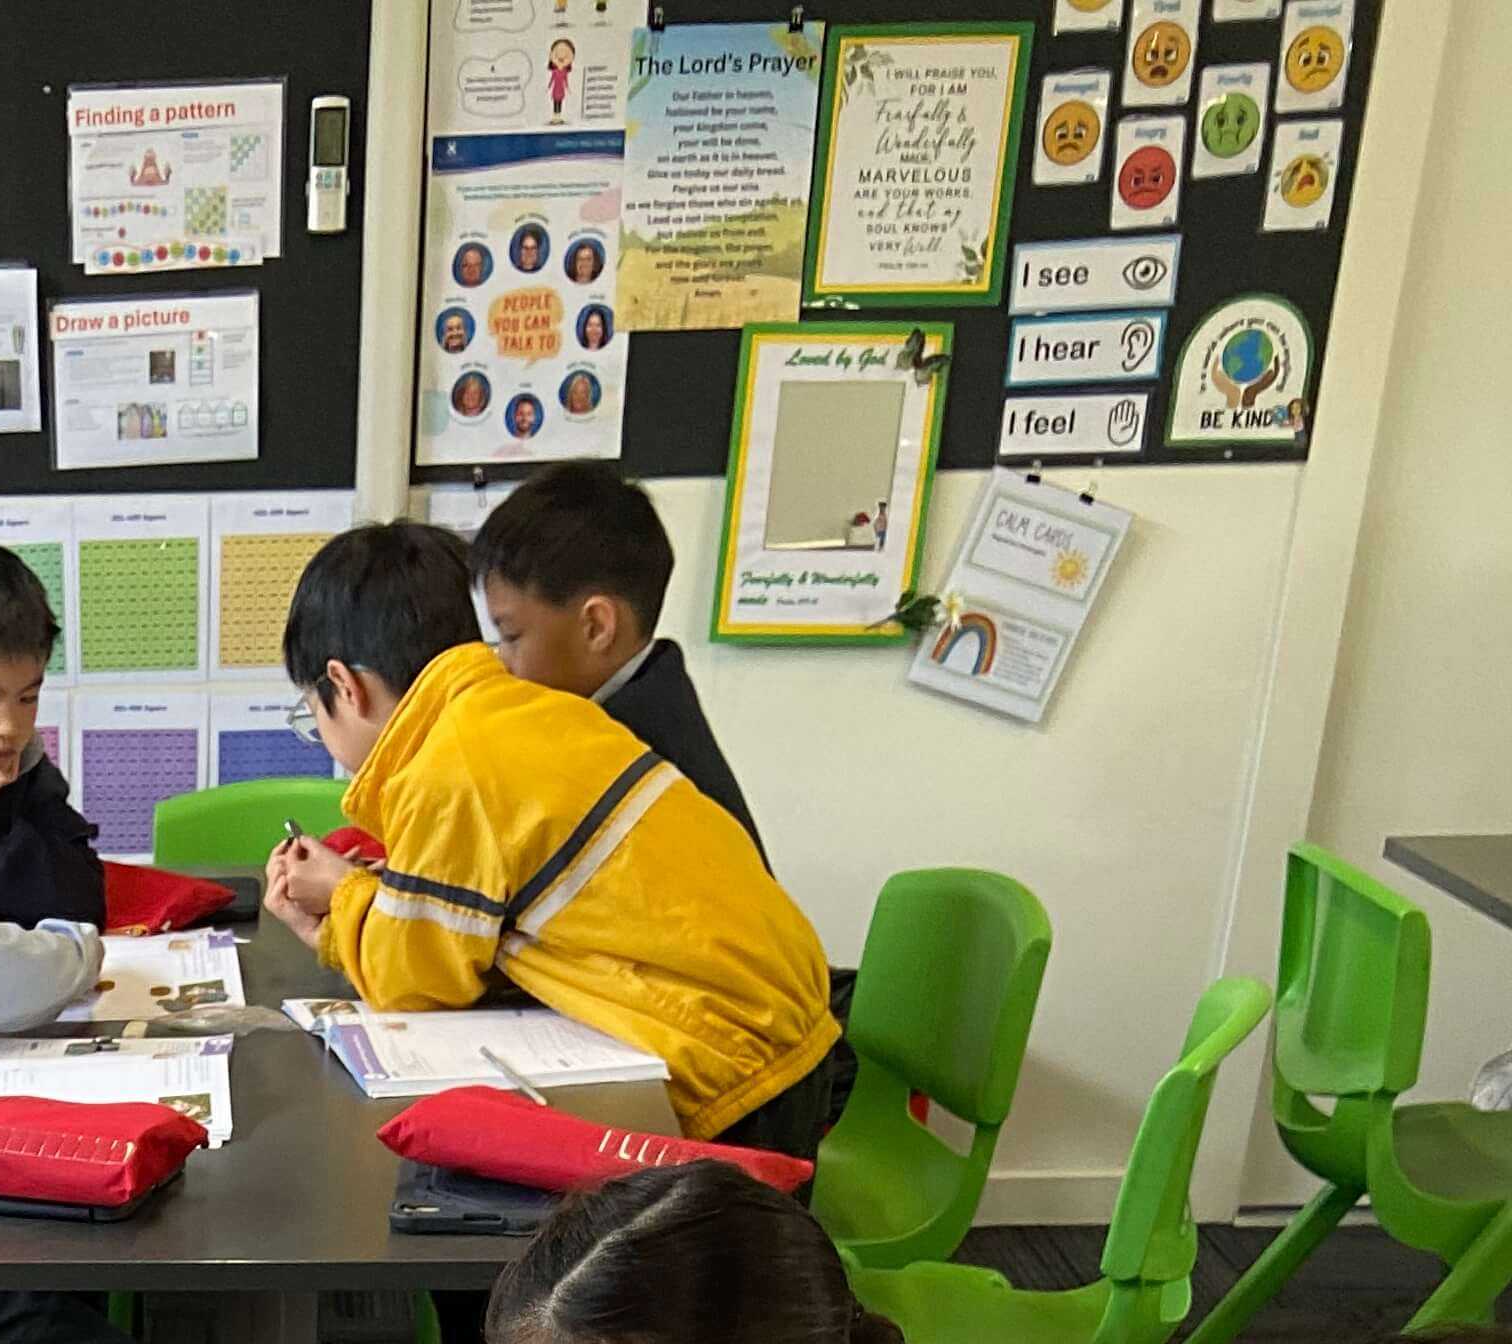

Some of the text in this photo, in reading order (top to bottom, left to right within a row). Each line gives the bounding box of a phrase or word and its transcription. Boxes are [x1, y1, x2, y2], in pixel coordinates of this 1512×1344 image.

[637, 53, 816, 77] The Lord's Prayer
[895, 70, 919, 79] WILL
[925, 69, 964, 79] PRAISE
[910, 84, 967, 95] FOR I AM
[76, 101, 235, 128] Finding a pattern
[859, 168, 971, 183] MARVELOUS
[854, 190, 877, 199] ARE
[886, 189, 919, 199] YOUR
[867, 223, 947, 234] SOUL KNOWS
[870, 242, 900, 251] VERY
[1023, 263, 1089, 288] I see
[503, 294, 552, 311] PEOPLE
[56, 309, 191, 332] Draw a picture
[494, 316, 551, 333] YOU CAN
[503, 335, 556, 351] TALK TO
[1018, 337, 1100, 362] I hear
[785, 349, 887, 372] Loved by God
[1009, 409, 1075, 435] I feel
[1200, 409, 1274, 429] BE KIND
